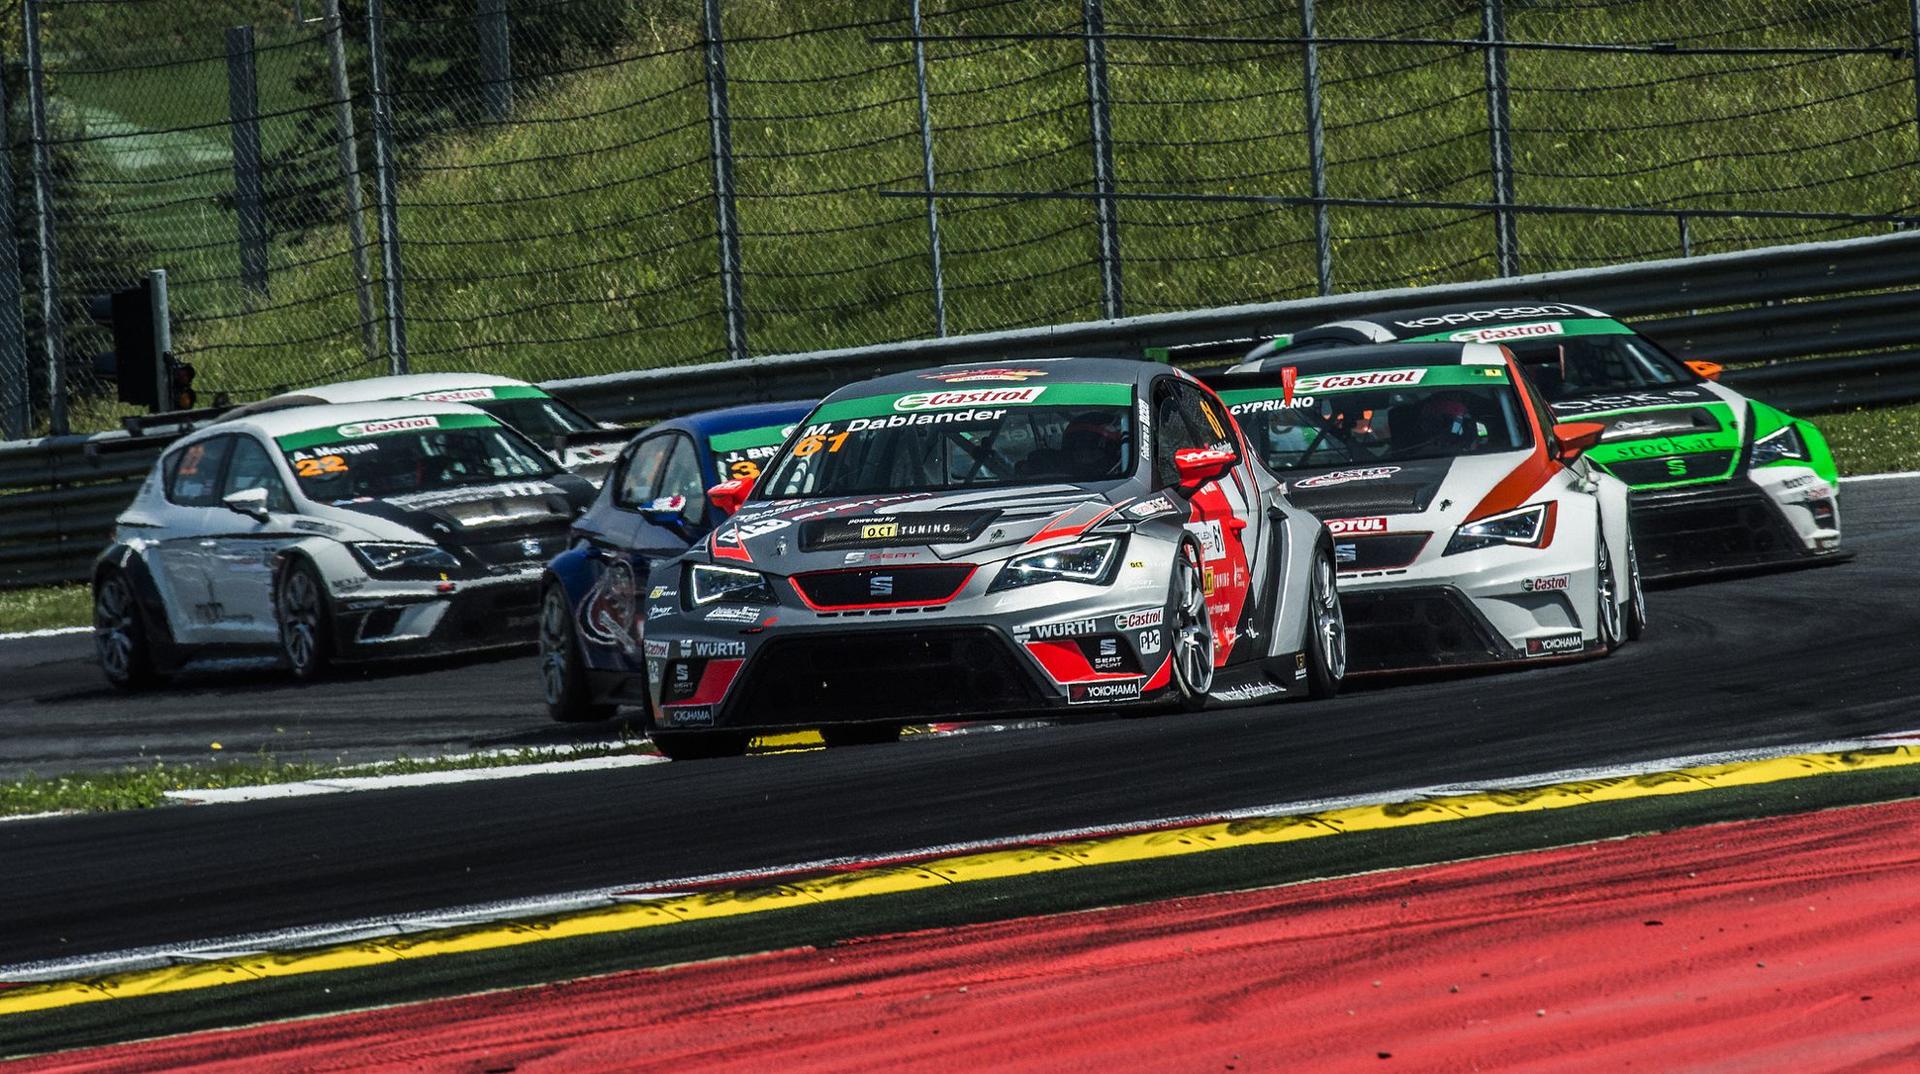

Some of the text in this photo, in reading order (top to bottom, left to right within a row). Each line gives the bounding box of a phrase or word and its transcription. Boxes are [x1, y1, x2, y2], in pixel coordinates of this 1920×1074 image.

[1480, 325, 1556, 341] Castrol
[1322, 369, 1416, 389] Castrol
[928, 389, 1034, 406] Castrol
[364, 418, 431, 433] Castrol
[804, 424, 834, 437] M.
[848, 409, 1007, 432] Dablander
[293, 442, 379, 461] A. Morgan
[793, 432, 849, 457] 61
[725, 452, 745, 463] J.
[295, 455, 349, 476] 22
[847, 515, 896, 526] powered by
[1326, 518, 1384, 533] OTUL
[901, 523, 951, 535] TUNING
[867, 552, 920, 560] SEAT
[1534, 577, 1568, 590] Castrol
[1128, 610, 1162, 628] Castrol
[1141, 630, 1160, 650] PPG
[1541, 636, 1582, 650] YOKOHAMA
[1094, 656, 1122, 664] SEAT
[1088, 682, 1138, 697] YOKOHAMA
